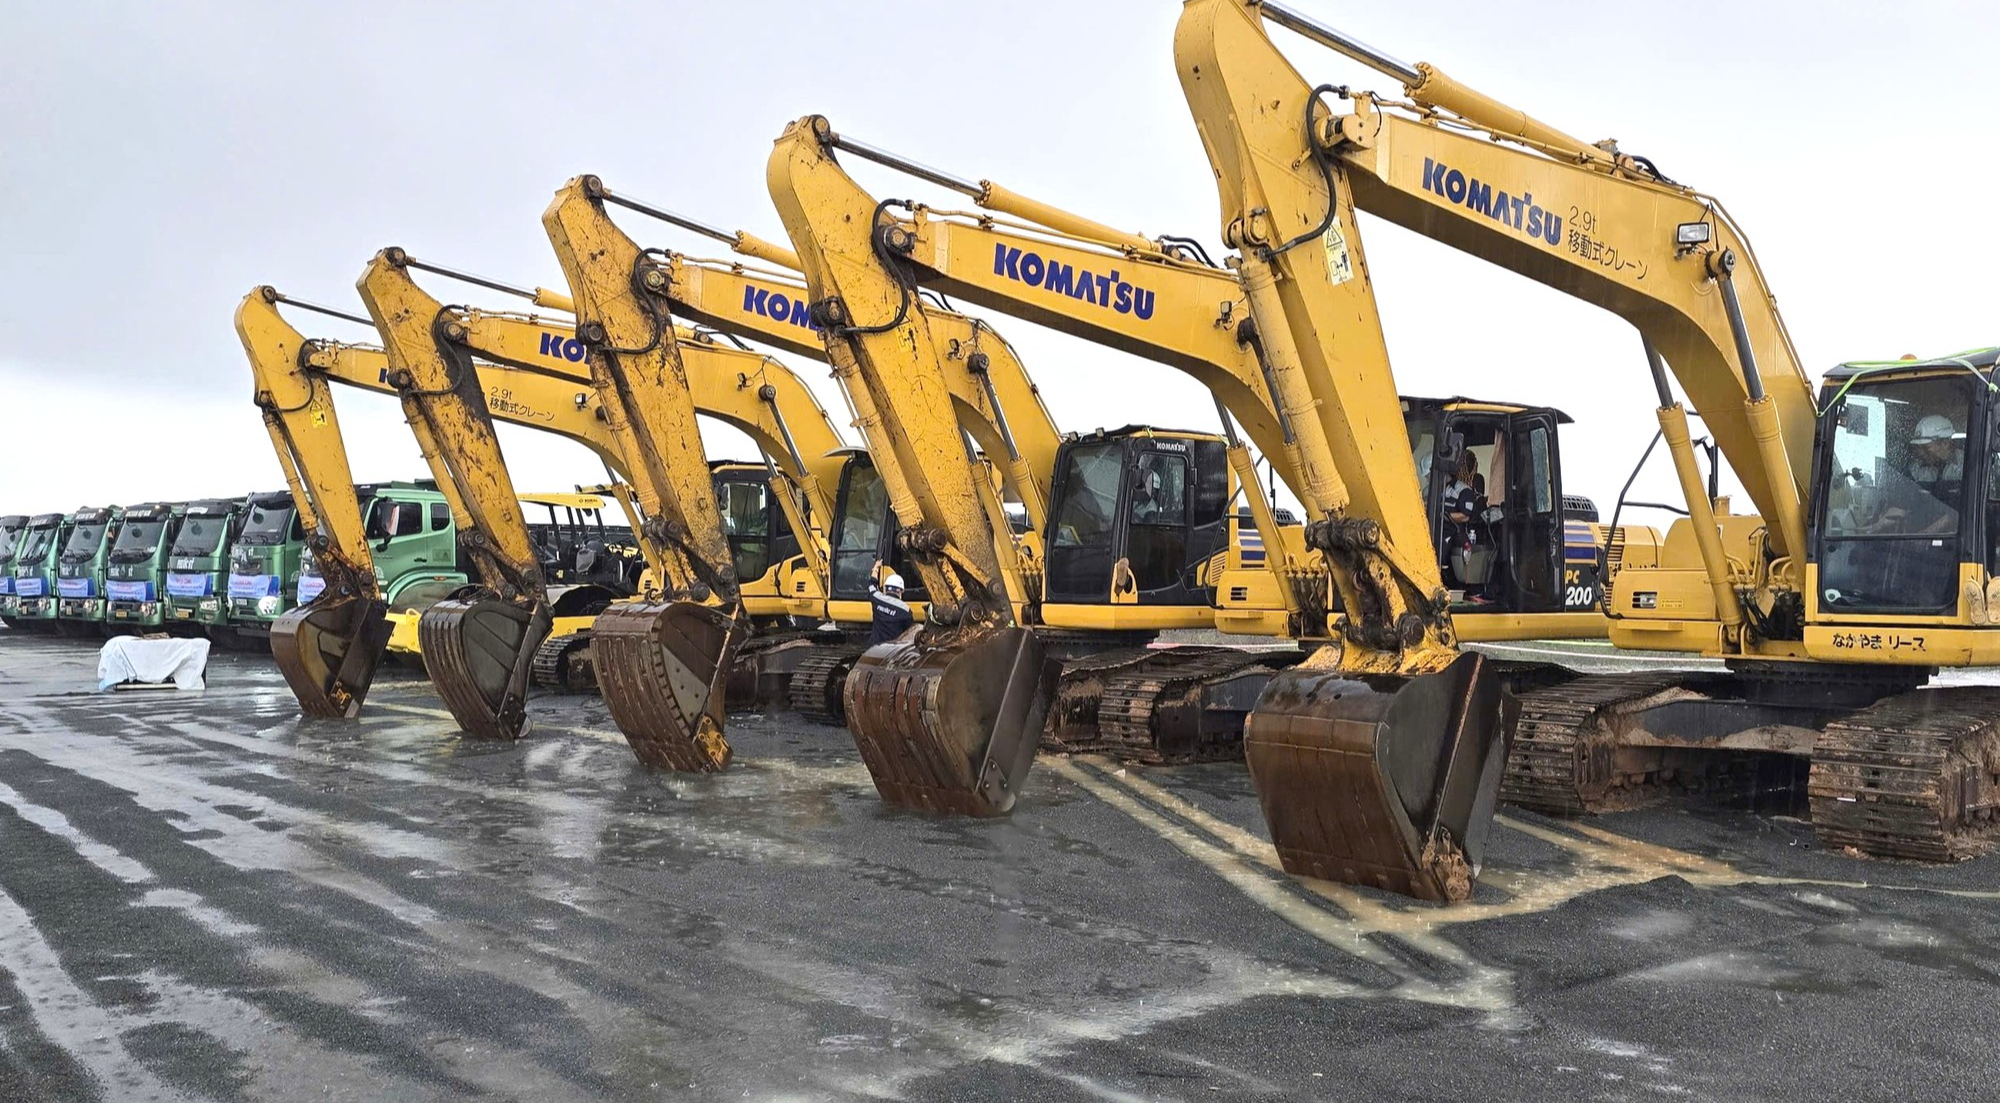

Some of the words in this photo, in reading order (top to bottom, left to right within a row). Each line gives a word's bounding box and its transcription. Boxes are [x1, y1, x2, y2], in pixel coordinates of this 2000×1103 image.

[1422, 157, 1562, 246] KOMATSU
[1569, 205, 1597, 234] 2.9t
[1568, 229, 1648, 279] 移動式クレーン
[994, 243, 1155, 320] KOMATSU
[743, 284, 822, 331] KOM
[490, 386, 512, 400] 2.9t
[490, 397, 555, 421] 移動式クレーン
[1156, 442, 1186, 451] KOMATSU
[1565, 570, 1580, 584] PC
[1565, 586, 1592, 605] 200
